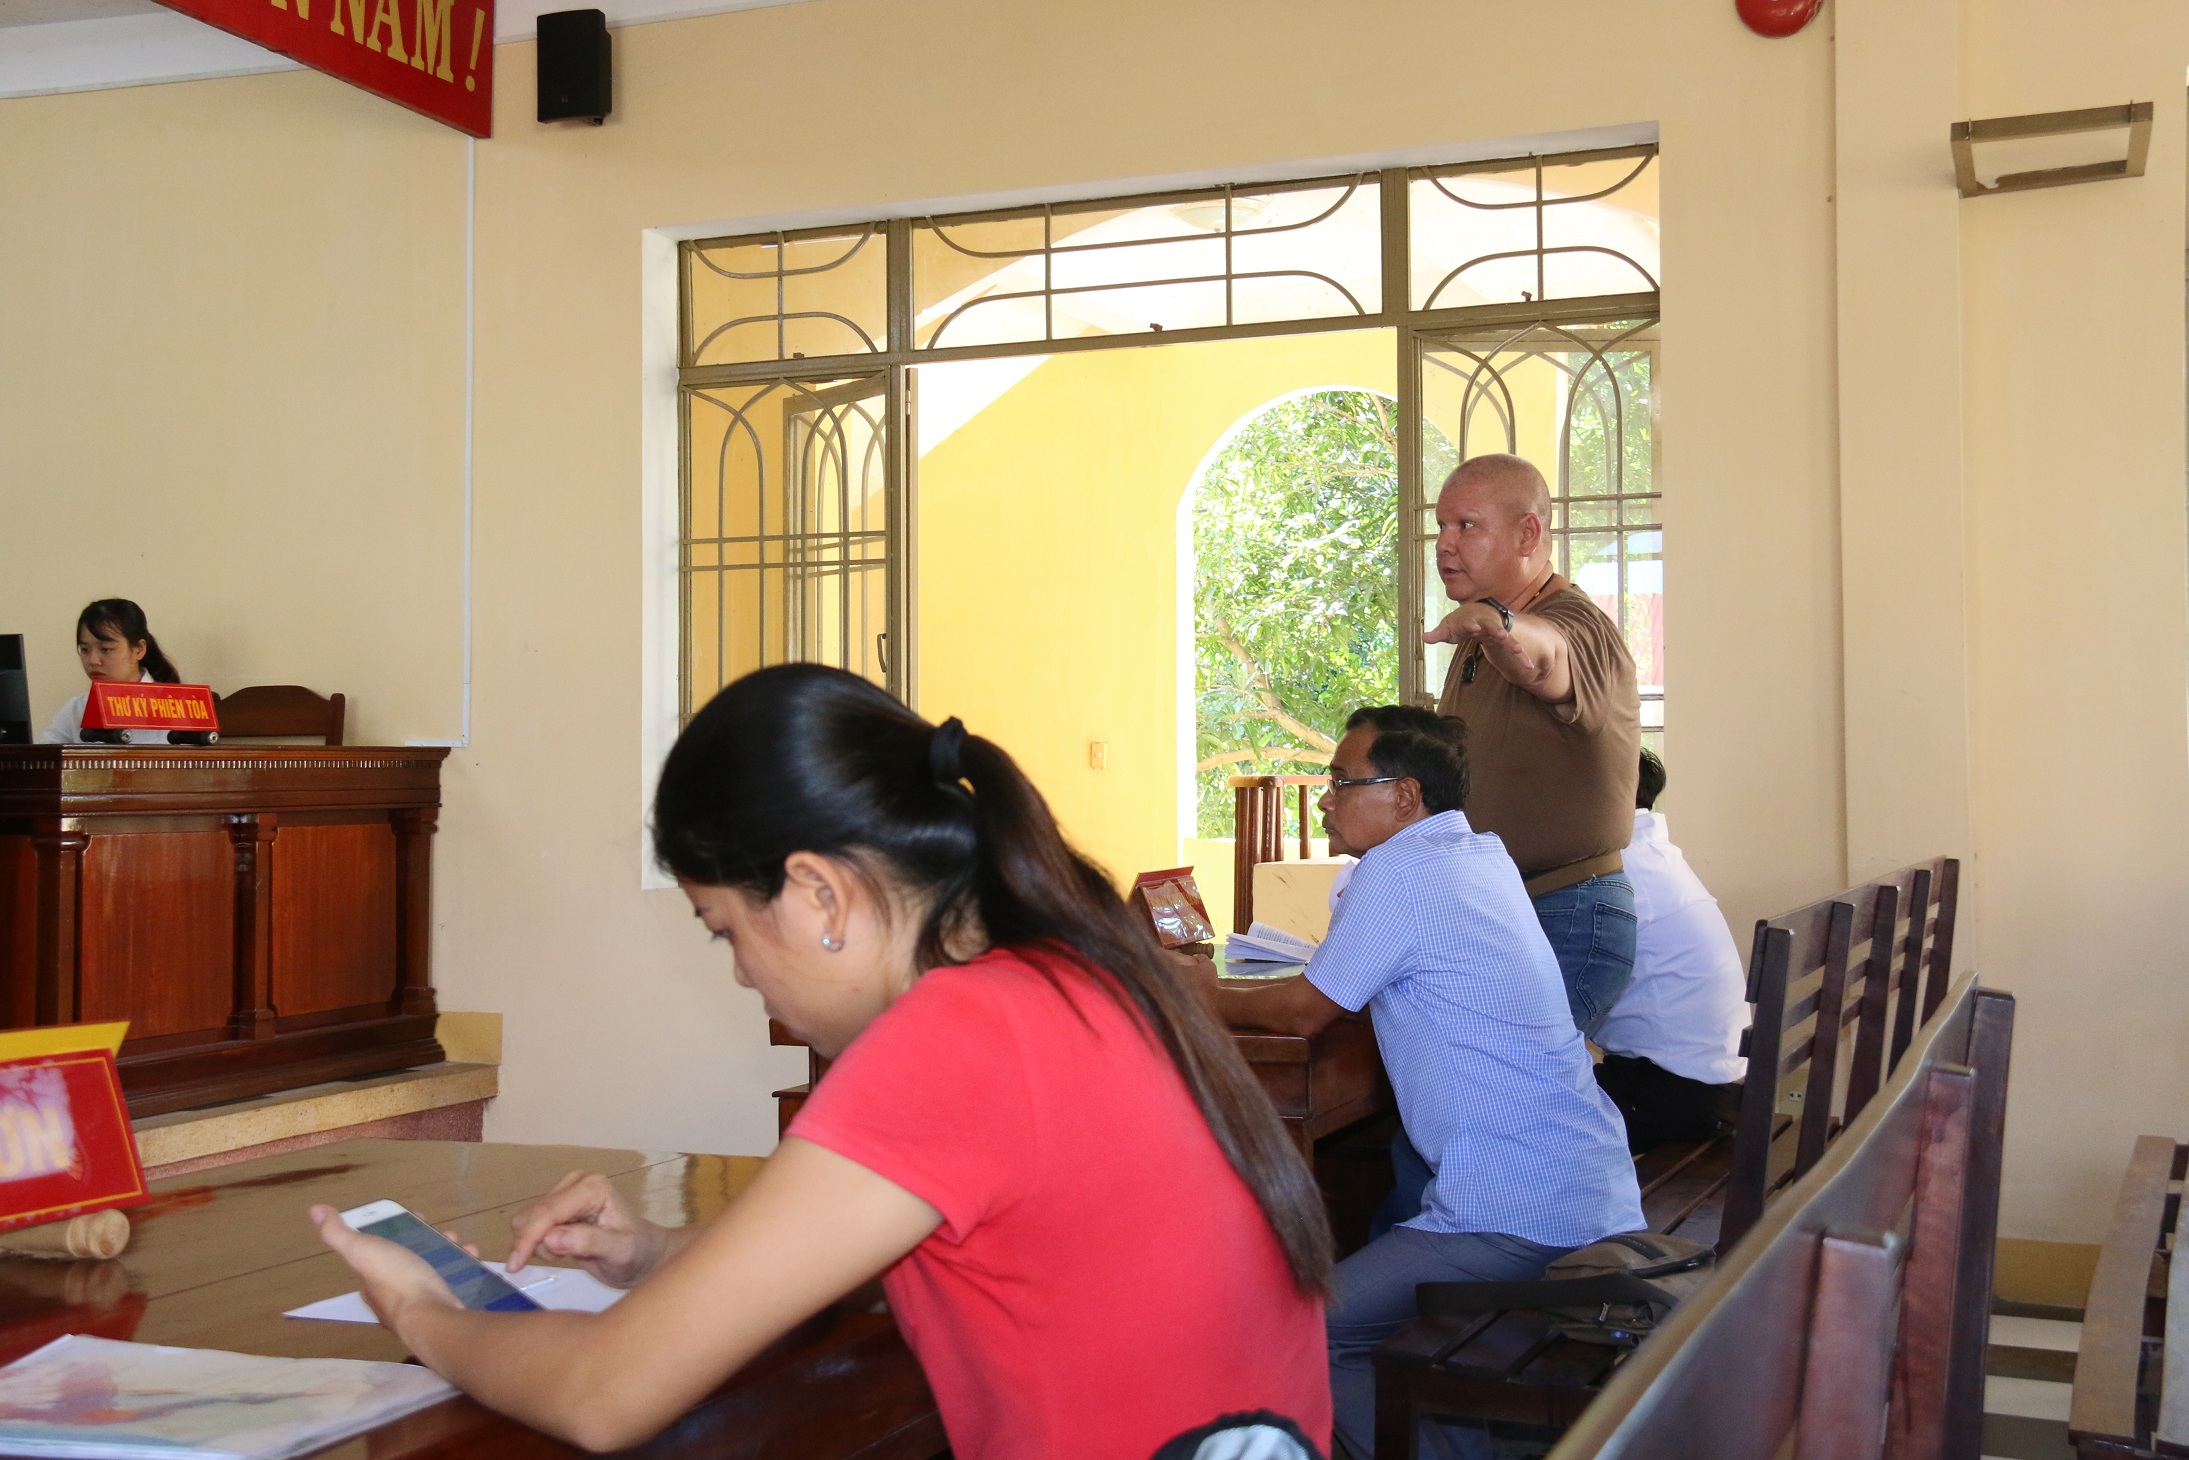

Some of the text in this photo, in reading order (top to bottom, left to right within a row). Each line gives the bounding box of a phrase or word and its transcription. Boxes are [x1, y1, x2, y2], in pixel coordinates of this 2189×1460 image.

[107, 694, 209, 719] THƯ KÝ PHIÊN TÒA
